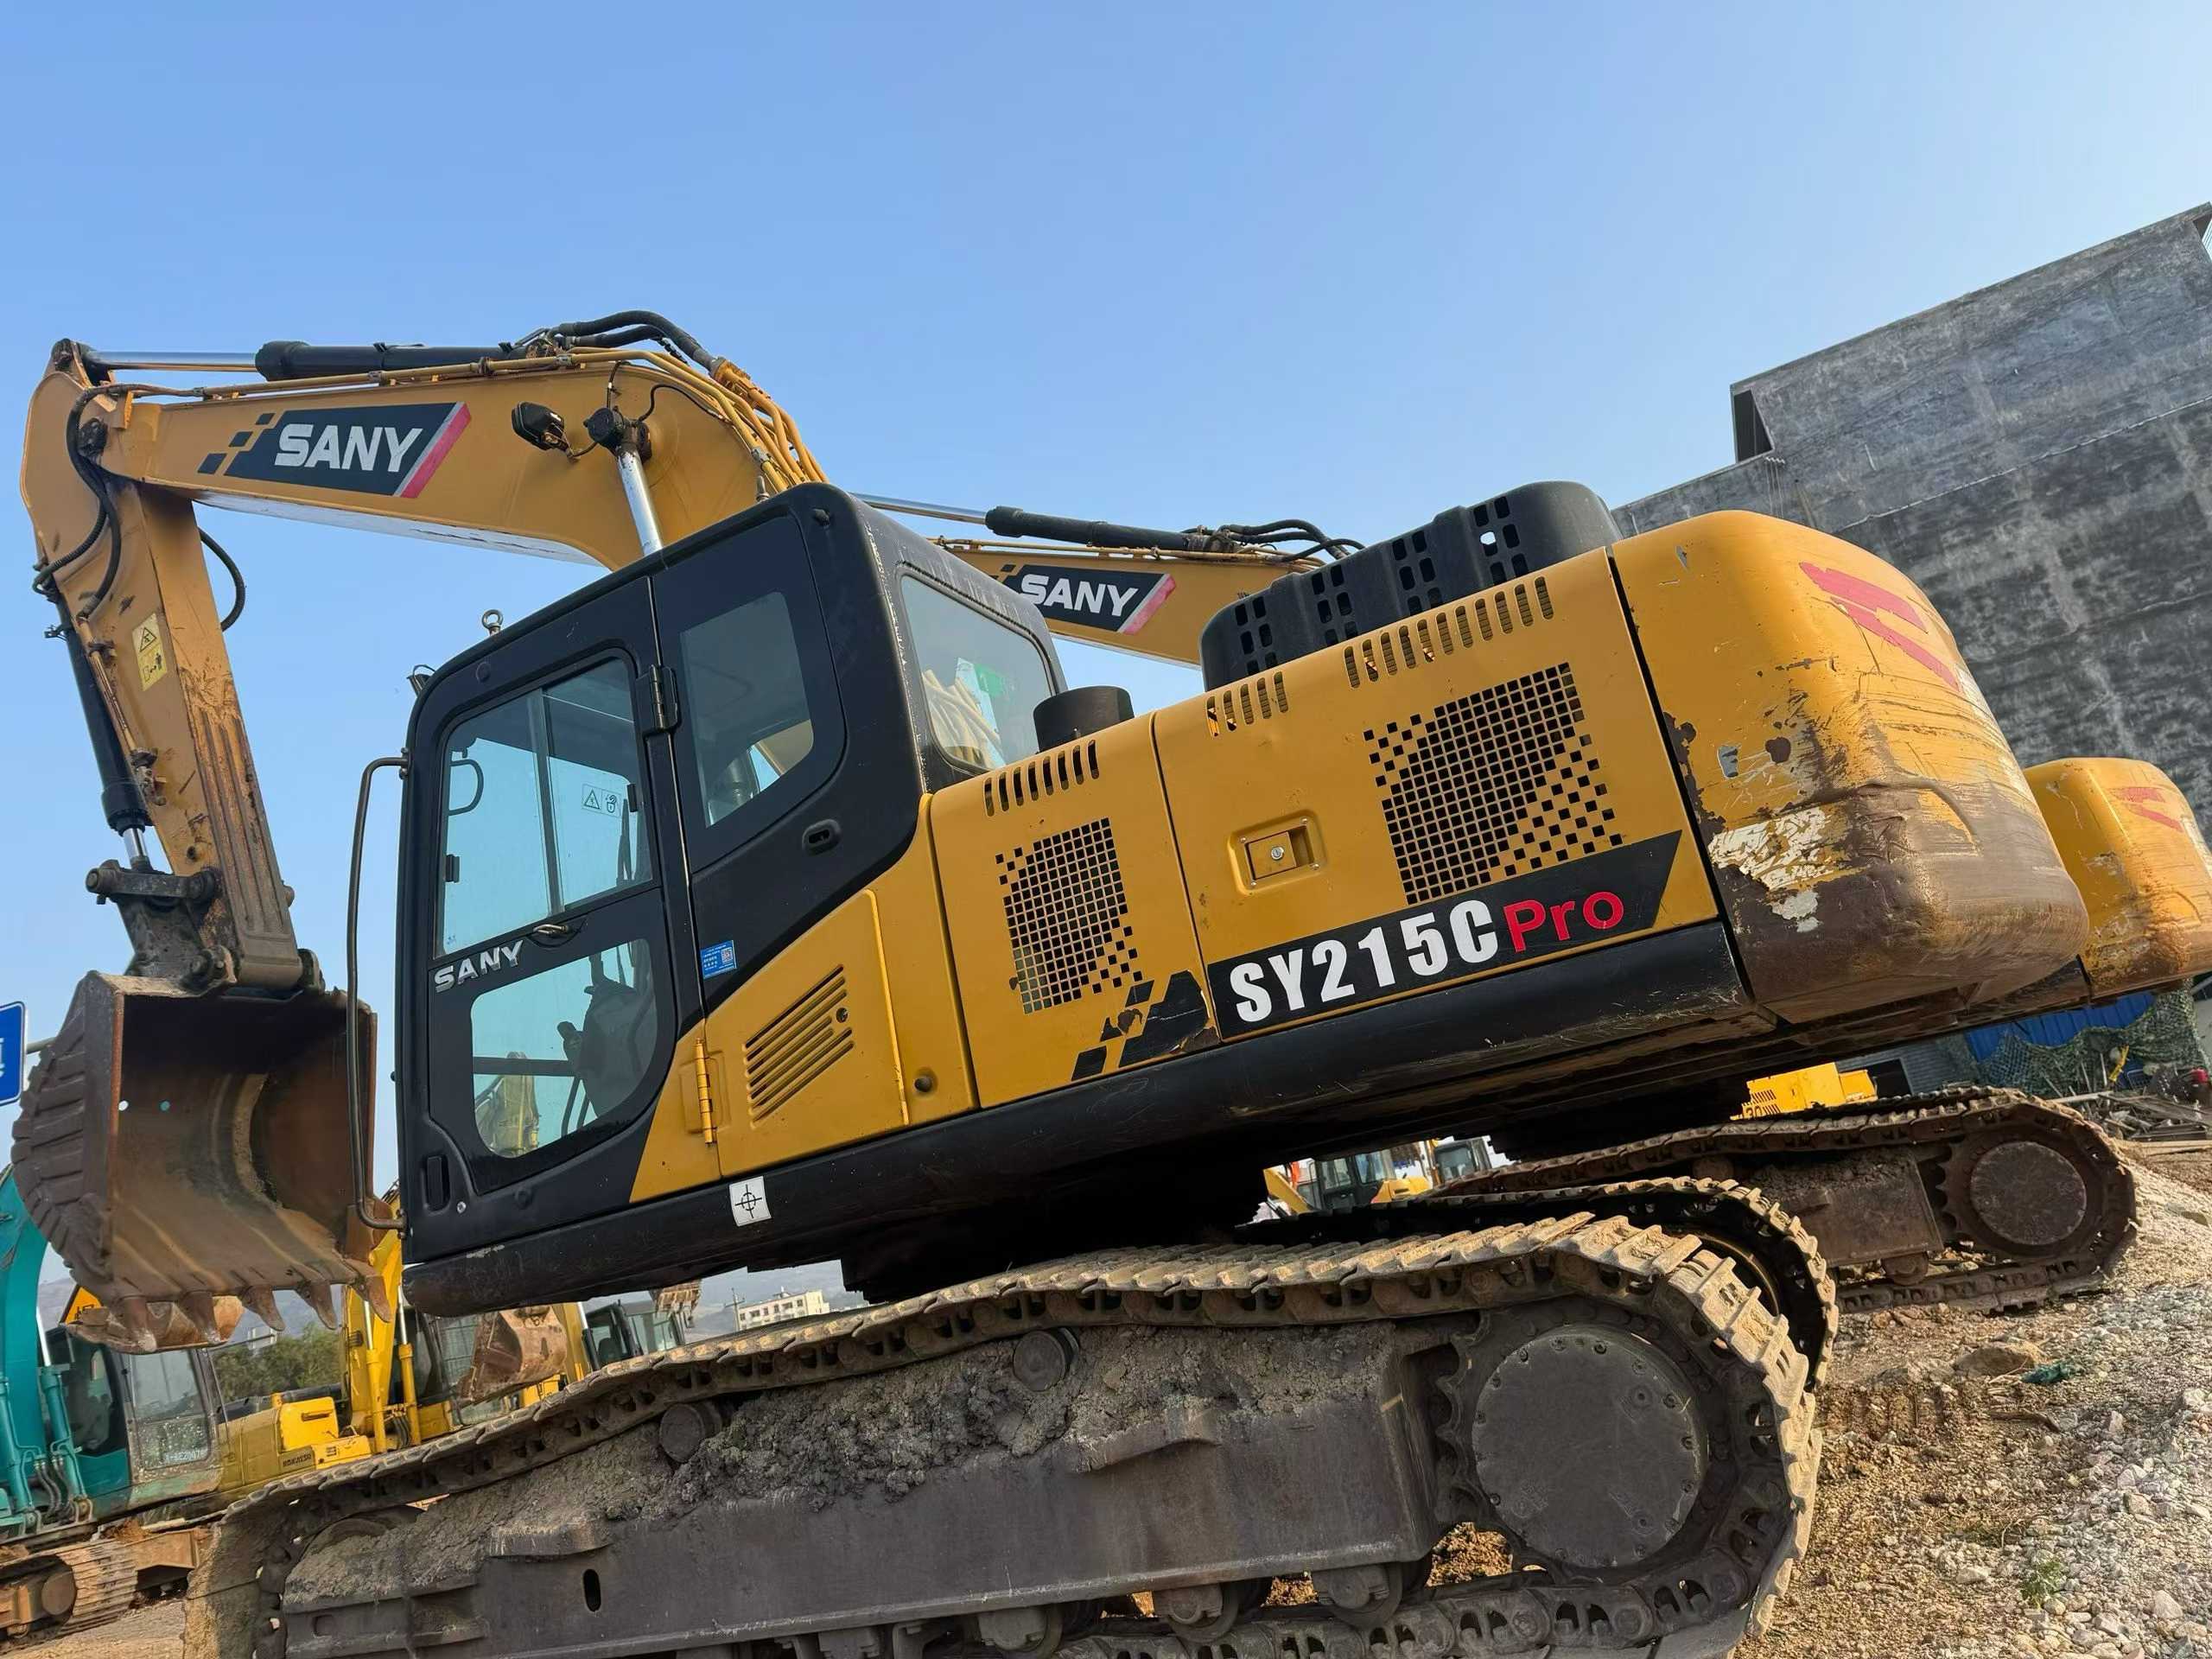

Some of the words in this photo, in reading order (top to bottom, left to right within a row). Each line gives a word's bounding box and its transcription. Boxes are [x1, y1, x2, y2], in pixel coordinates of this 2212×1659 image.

[274, 423, 423, 473] SANY
[1020, 574, 1139, 617] SANY
[435, 940, 523, 993] SANY
[1230, 899, 1498, 1022] SY215C
[1503, 891, 1624, 954] Pro
